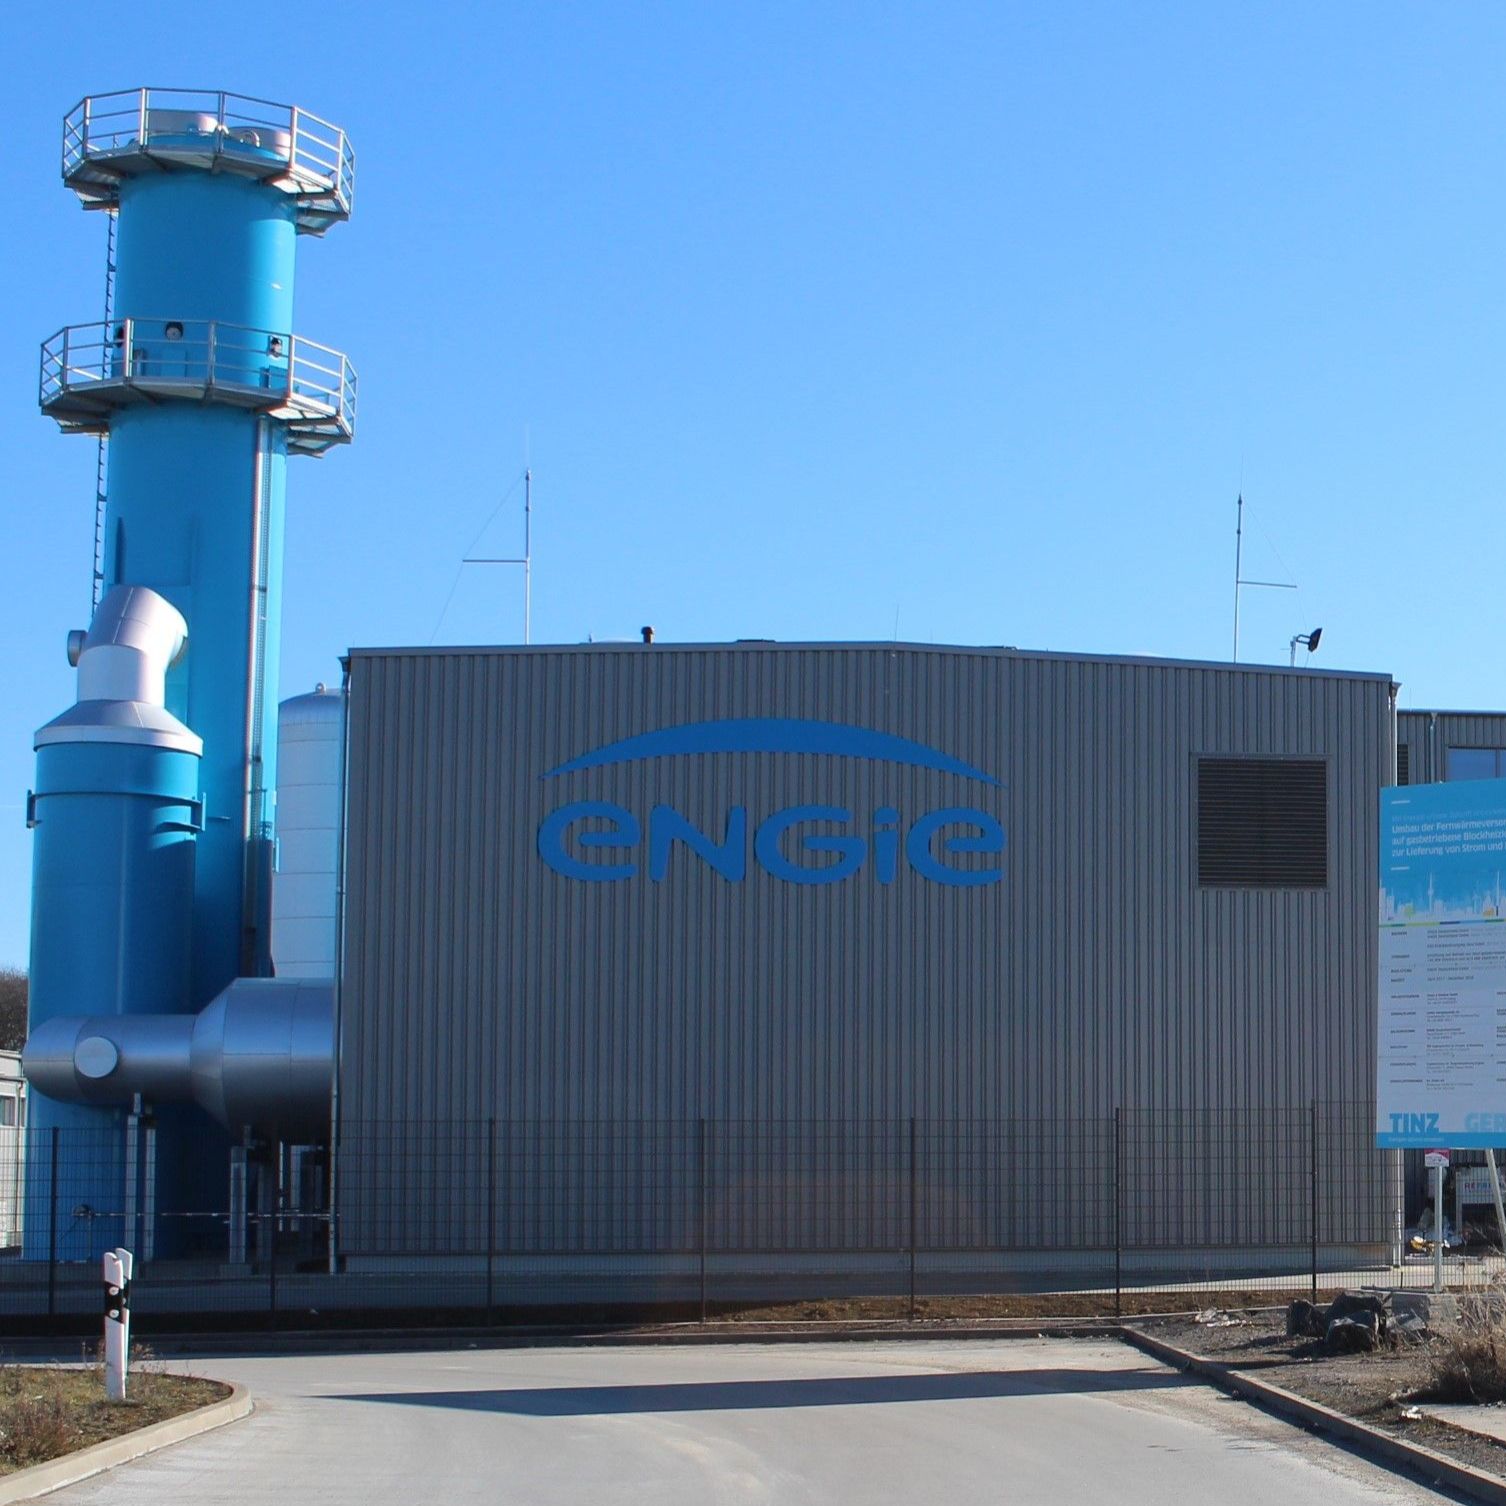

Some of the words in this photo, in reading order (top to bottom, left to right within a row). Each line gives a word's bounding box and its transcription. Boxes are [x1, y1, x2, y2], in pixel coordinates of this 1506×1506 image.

[1392, 824, 1420, 834] Umbau
[1421, 822, 1435, 833] der
[1392, 835, 1405, 846] auf
[1392, 848, 1405, 858] zur
[1406, 845, 1444, 858] Lieferung
[1444, 845, 1460, 854] von
[1461, 843, 1486, 853] Strom
[1487, 840, 1504, 851] und
[1389, 1112, 1440, 1134] TINZ
